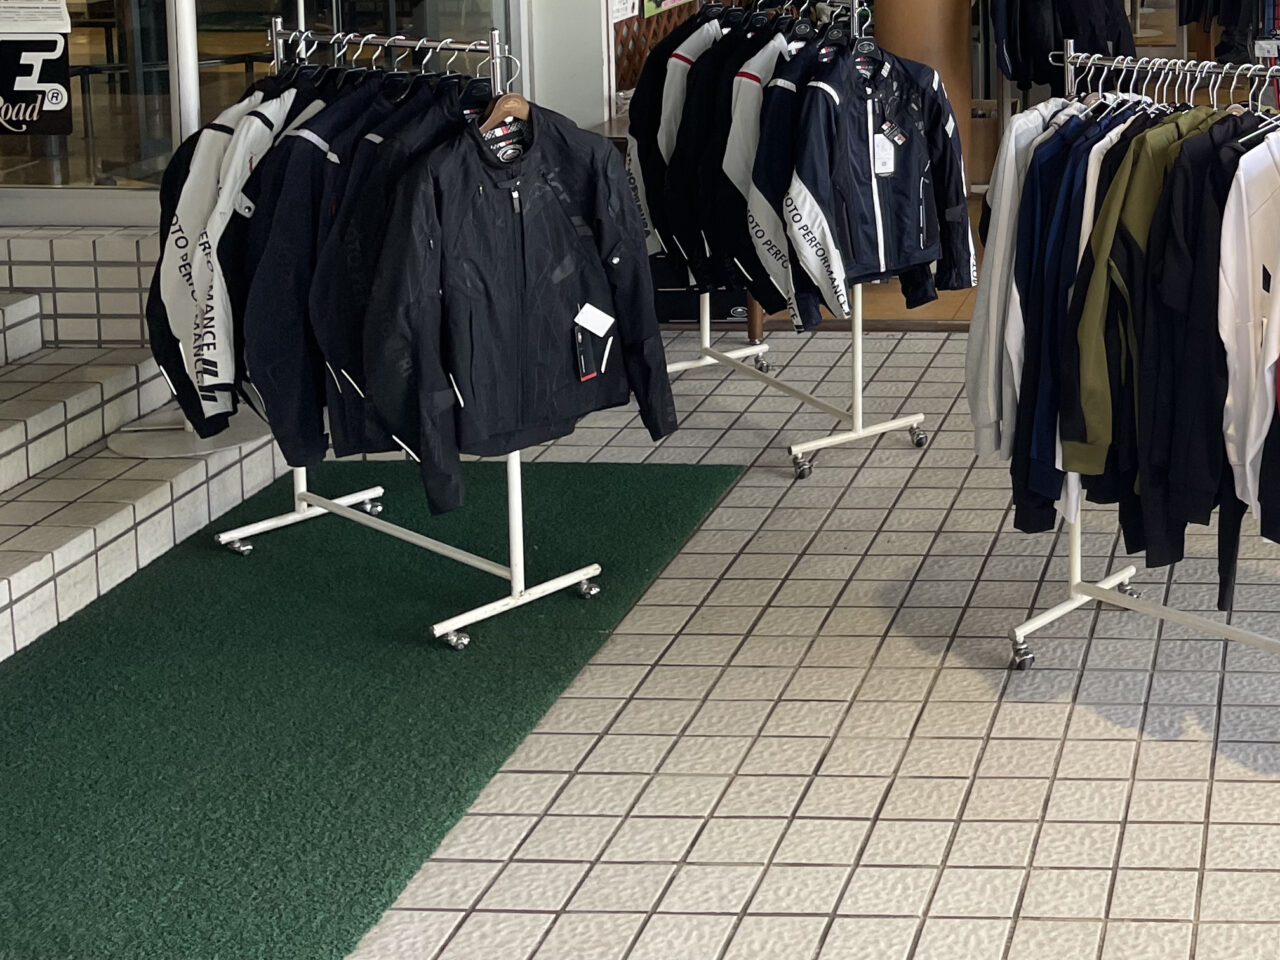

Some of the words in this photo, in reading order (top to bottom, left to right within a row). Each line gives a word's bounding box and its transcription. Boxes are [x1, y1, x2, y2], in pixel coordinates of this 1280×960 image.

[784, 192, 803, 224] OTO
[171, 212, 189, 249] OTO
[748, 210, 766, 239] OTO
